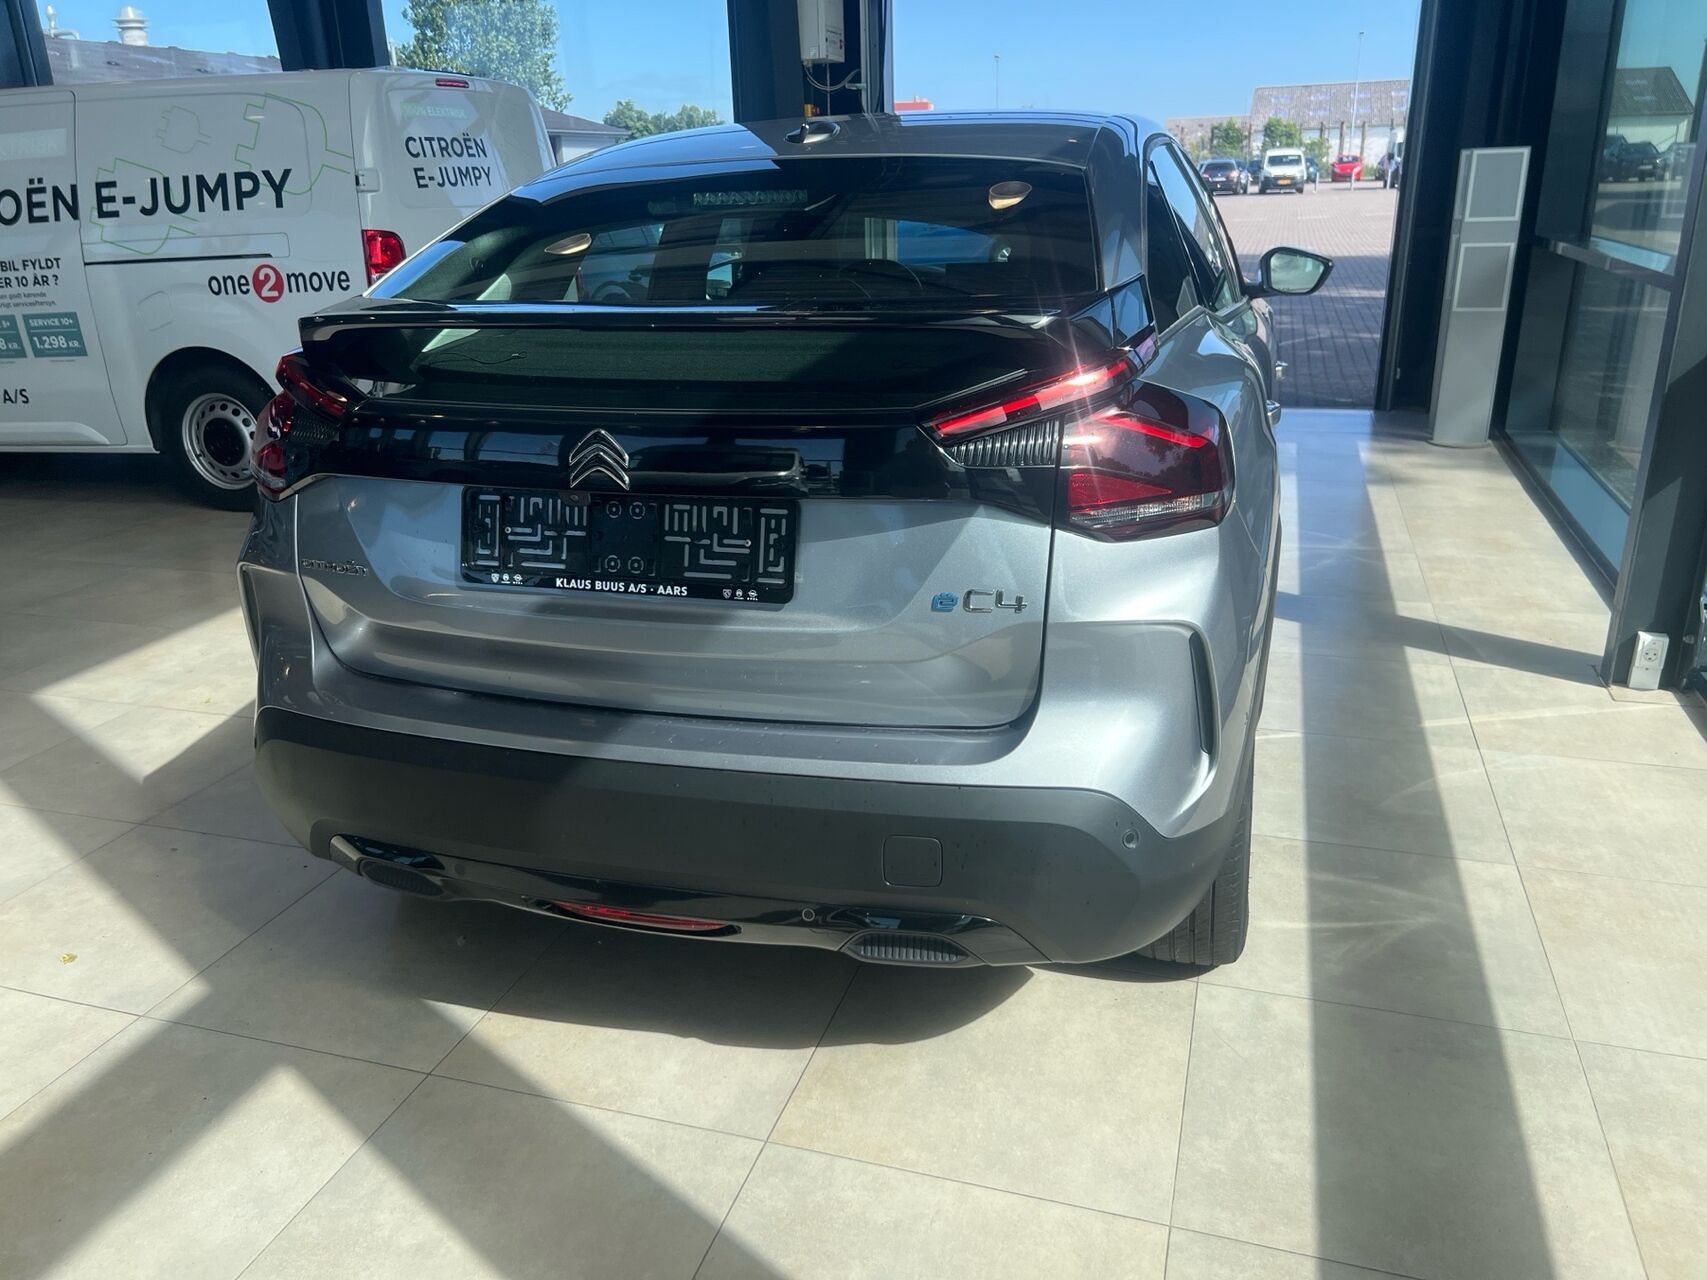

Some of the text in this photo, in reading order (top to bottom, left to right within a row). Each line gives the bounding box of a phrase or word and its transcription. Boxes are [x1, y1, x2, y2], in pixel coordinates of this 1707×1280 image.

[405, 132, 487, 158] CITROËN
[413, 166, 492, 189] E-JUMPY
[95, 168, 292, 219] E-JUMPY
[0, 257, 61, 272] BIL FYLDT
[15, 276, 28, 287] 10
[33, 272, 50, 287] ÅR
[29, 319, 59, 327] SERVICE
[33, 336, 68, 349] 1.298
[3, 388, 30, 404] A/S
[556, 578, 688, 597] KLAUS BUUS A/S AARS
